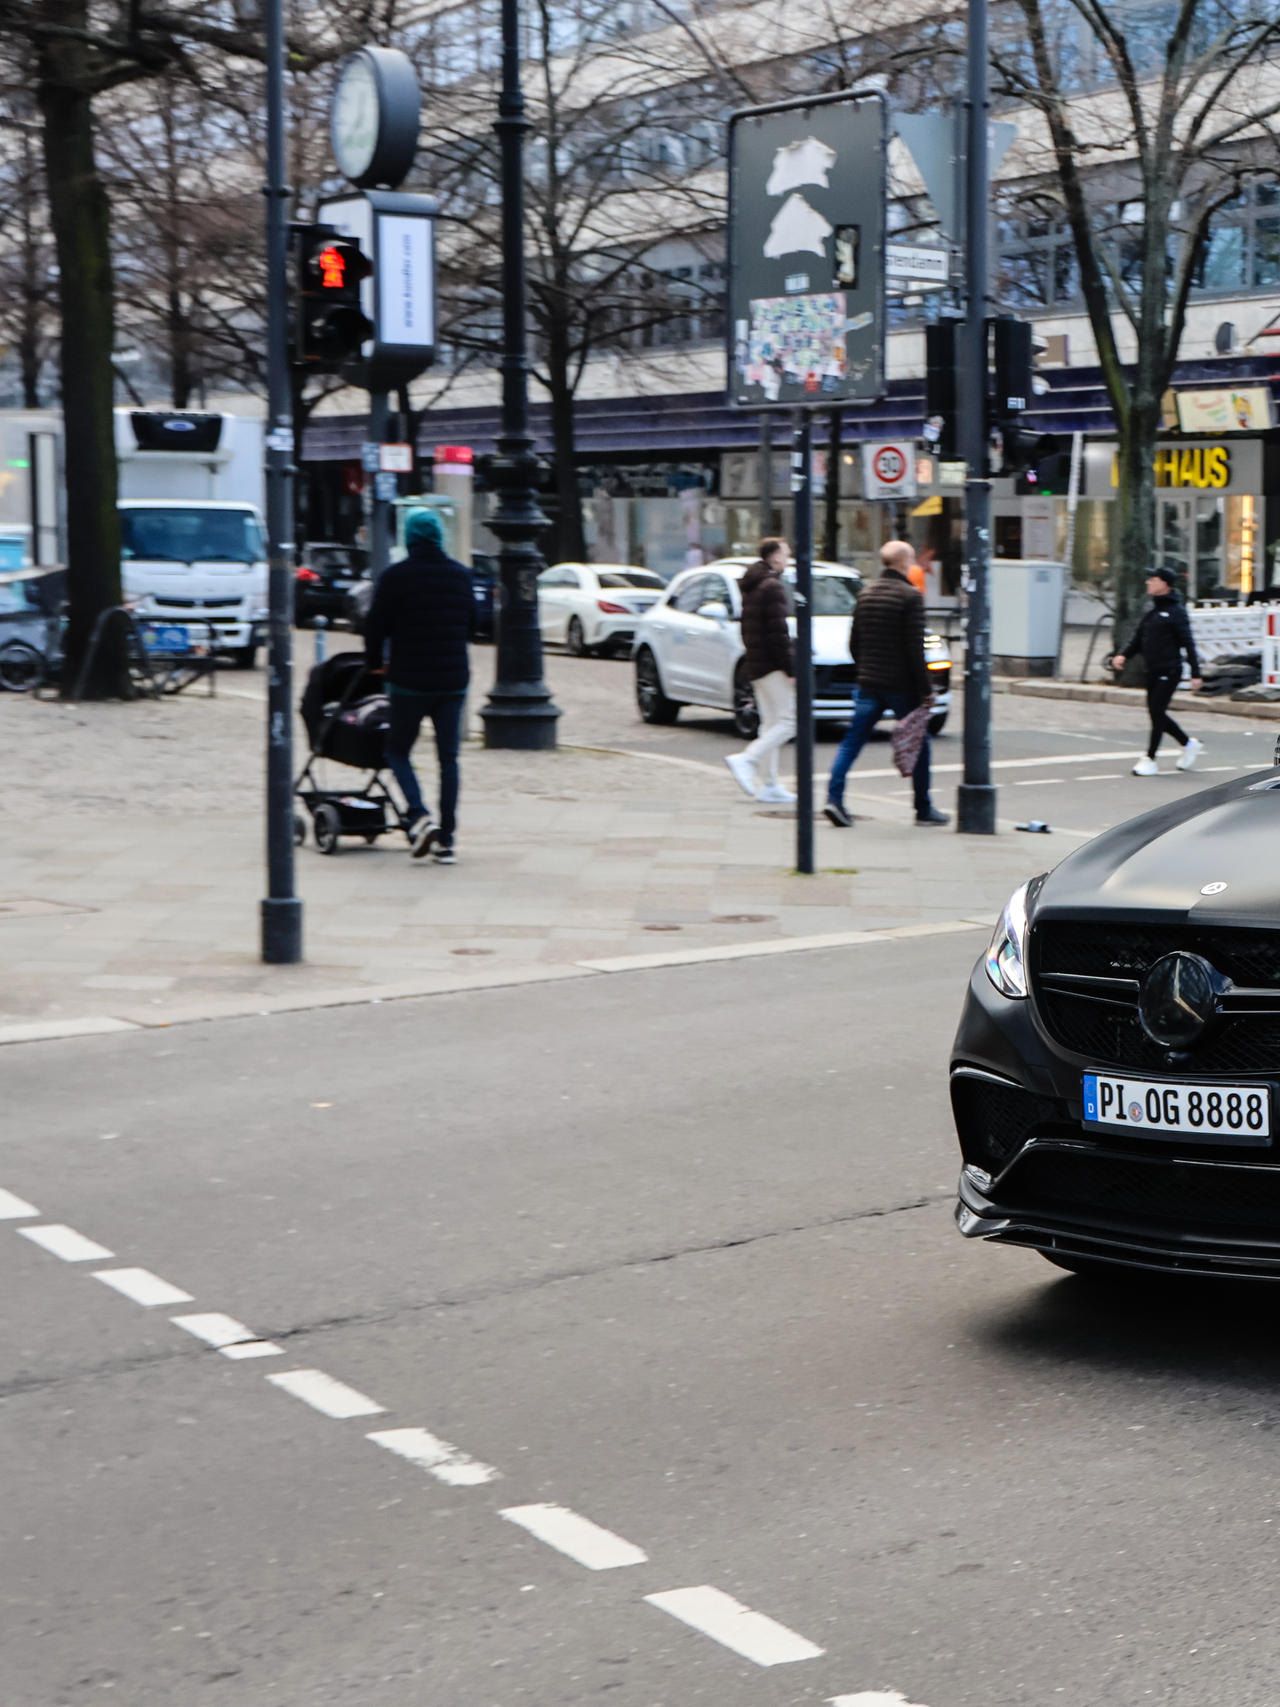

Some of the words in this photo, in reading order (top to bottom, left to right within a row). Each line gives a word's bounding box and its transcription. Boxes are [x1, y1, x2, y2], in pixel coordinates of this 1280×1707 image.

[880, 456, 901, 475] 30
[1087, 1102, 1095, 1114] D
[1099, 1081, 1128, 1121] PI
[1145, 1087, 1181, 1126] OG
[1187, 1090, 1264, 1131] 8888
